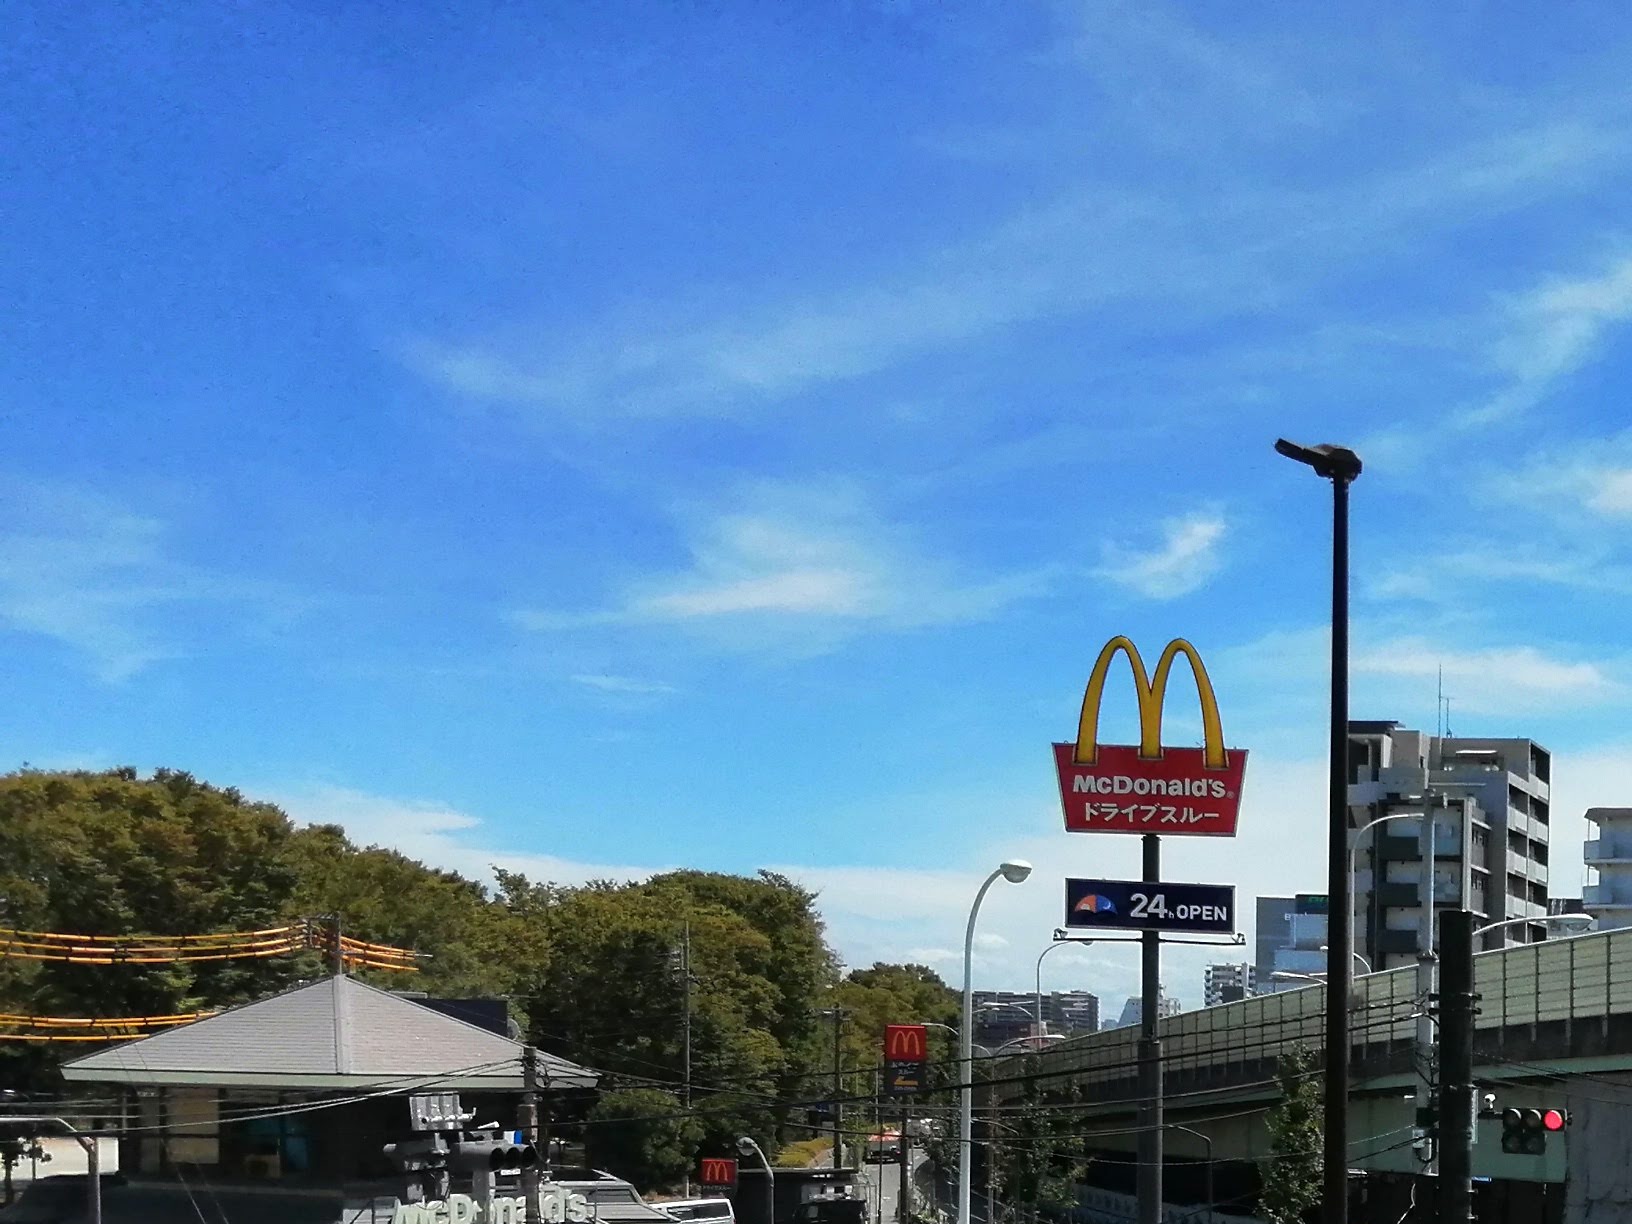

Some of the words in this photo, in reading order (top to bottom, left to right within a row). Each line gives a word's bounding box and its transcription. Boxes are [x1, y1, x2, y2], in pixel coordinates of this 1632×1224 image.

[1072, 774, 1227, 799] McDonald's
[1084, 801, 1220, 825] ドライブスルー
[1176, 904, 1227, 921] OPEN
